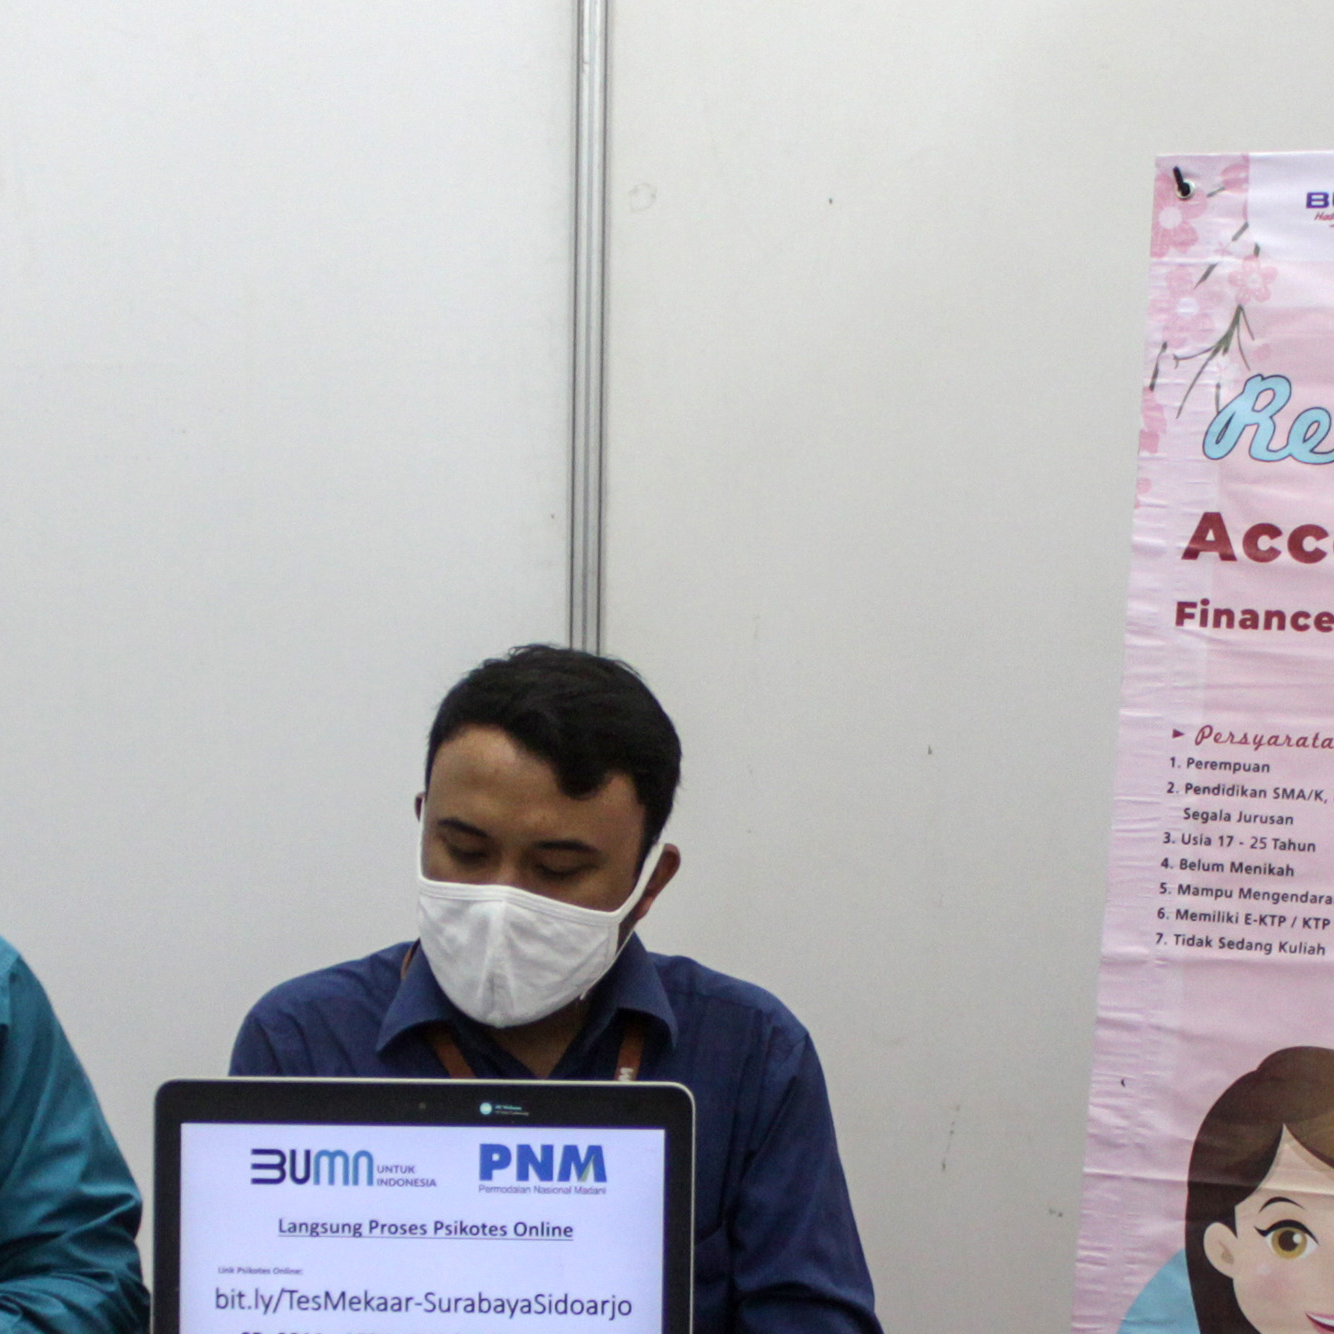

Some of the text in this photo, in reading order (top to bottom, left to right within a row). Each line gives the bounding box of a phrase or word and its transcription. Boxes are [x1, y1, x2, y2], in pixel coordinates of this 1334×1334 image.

[1175, 600, 1334, 632] Finance
[1187, 758, 1270, 774] Perempuan
[1185, 783, 1328, 804] Pendidikan SMA/K,
[1183, 808, 1294, 825] Segala Jurusan
[1181, 834, 1316, 852] Usia 17 25 Tahun
[1179, 859, 1294, 877] Belum Menikah
[1177, 884, 1233, 900] Mampu
[1175, 909, 1239, 924] Memiliki
[1245, 914, 1286, 928] E-KTP
[1302, 918, 1330, 931] KTP
[1174, 934, 1325, 956] Tidak Sedang Kuliah
[377, 1165, 415, 1175] UNTUK
[479, 1143, 607, 1183] PNM
[377, 1178, 436, 1188] INDONESIA
[479, 1184, 606, 1195] Permodalan Nasional Madani
[279, 1218, 574, 1239] Langsung Proses Psikotes Online
[237, 1266, 271, 1275] Psikotes
[215, 1288, 632, 1321] bit.ly/TesMekaar-SurabayaSidoarjo
